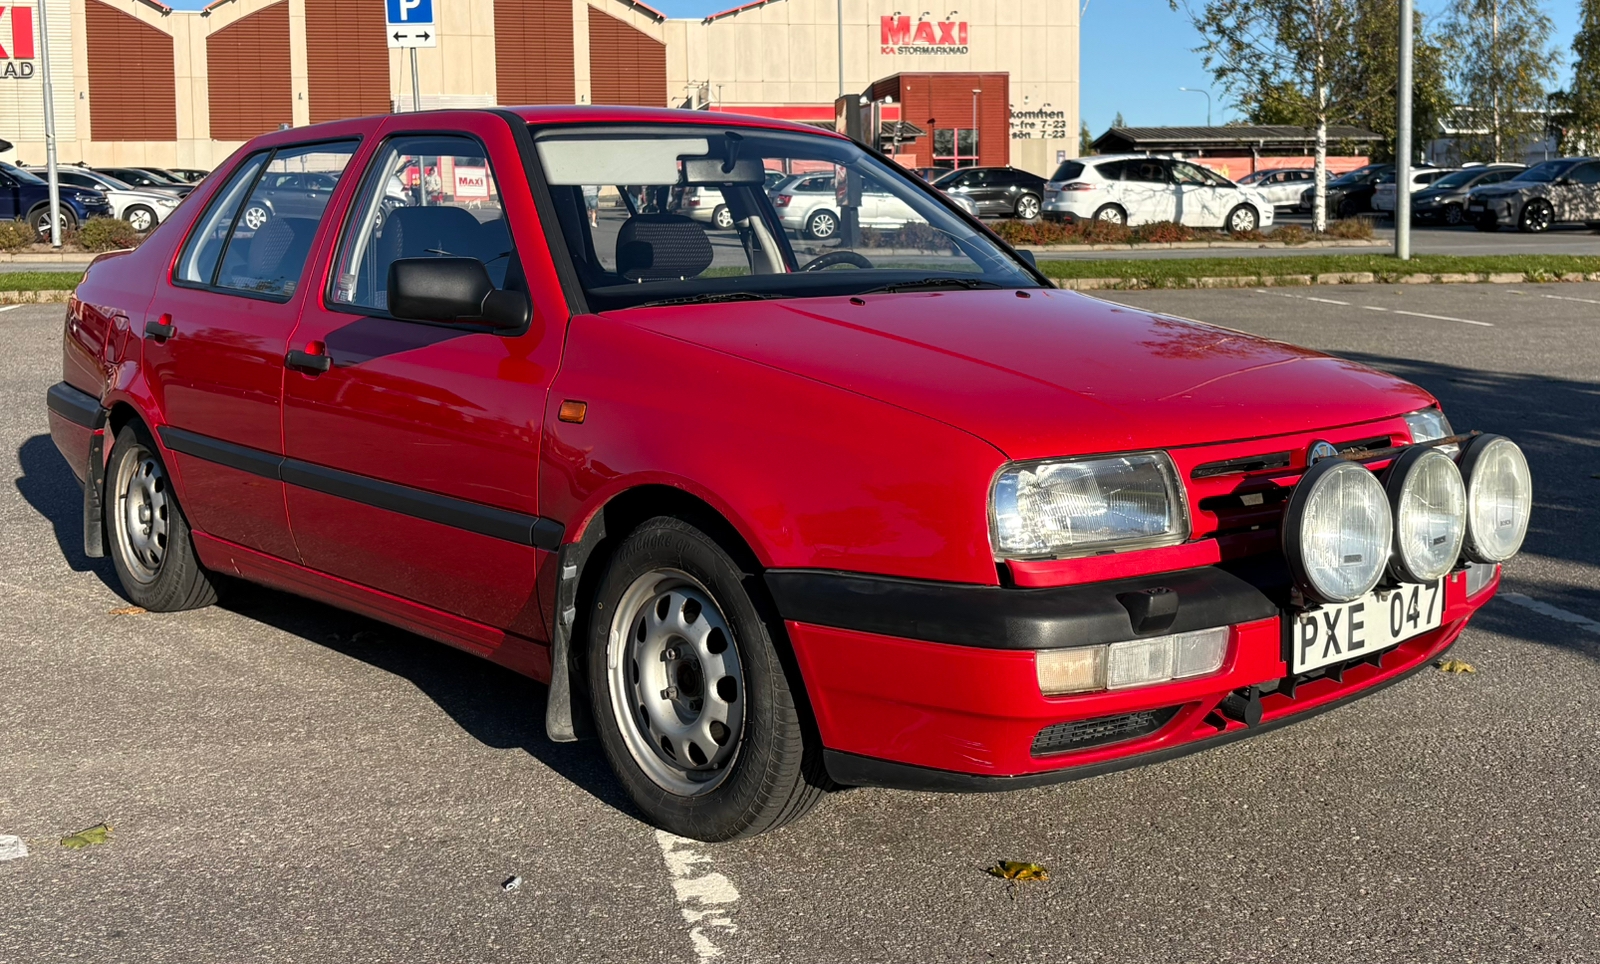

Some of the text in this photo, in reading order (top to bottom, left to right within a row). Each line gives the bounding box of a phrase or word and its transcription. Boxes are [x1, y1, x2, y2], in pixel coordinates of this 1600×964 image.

[400, 0, 421, 21] P
[898, 46, 968, 55] STORMARKNAD
[0, 61, 34, 79] AD
[1040, 120, 1067, 129] 7-23
[1040, 130, 1066, 139] 7-23
[1300, 581, 1440, 666] PXE 047
